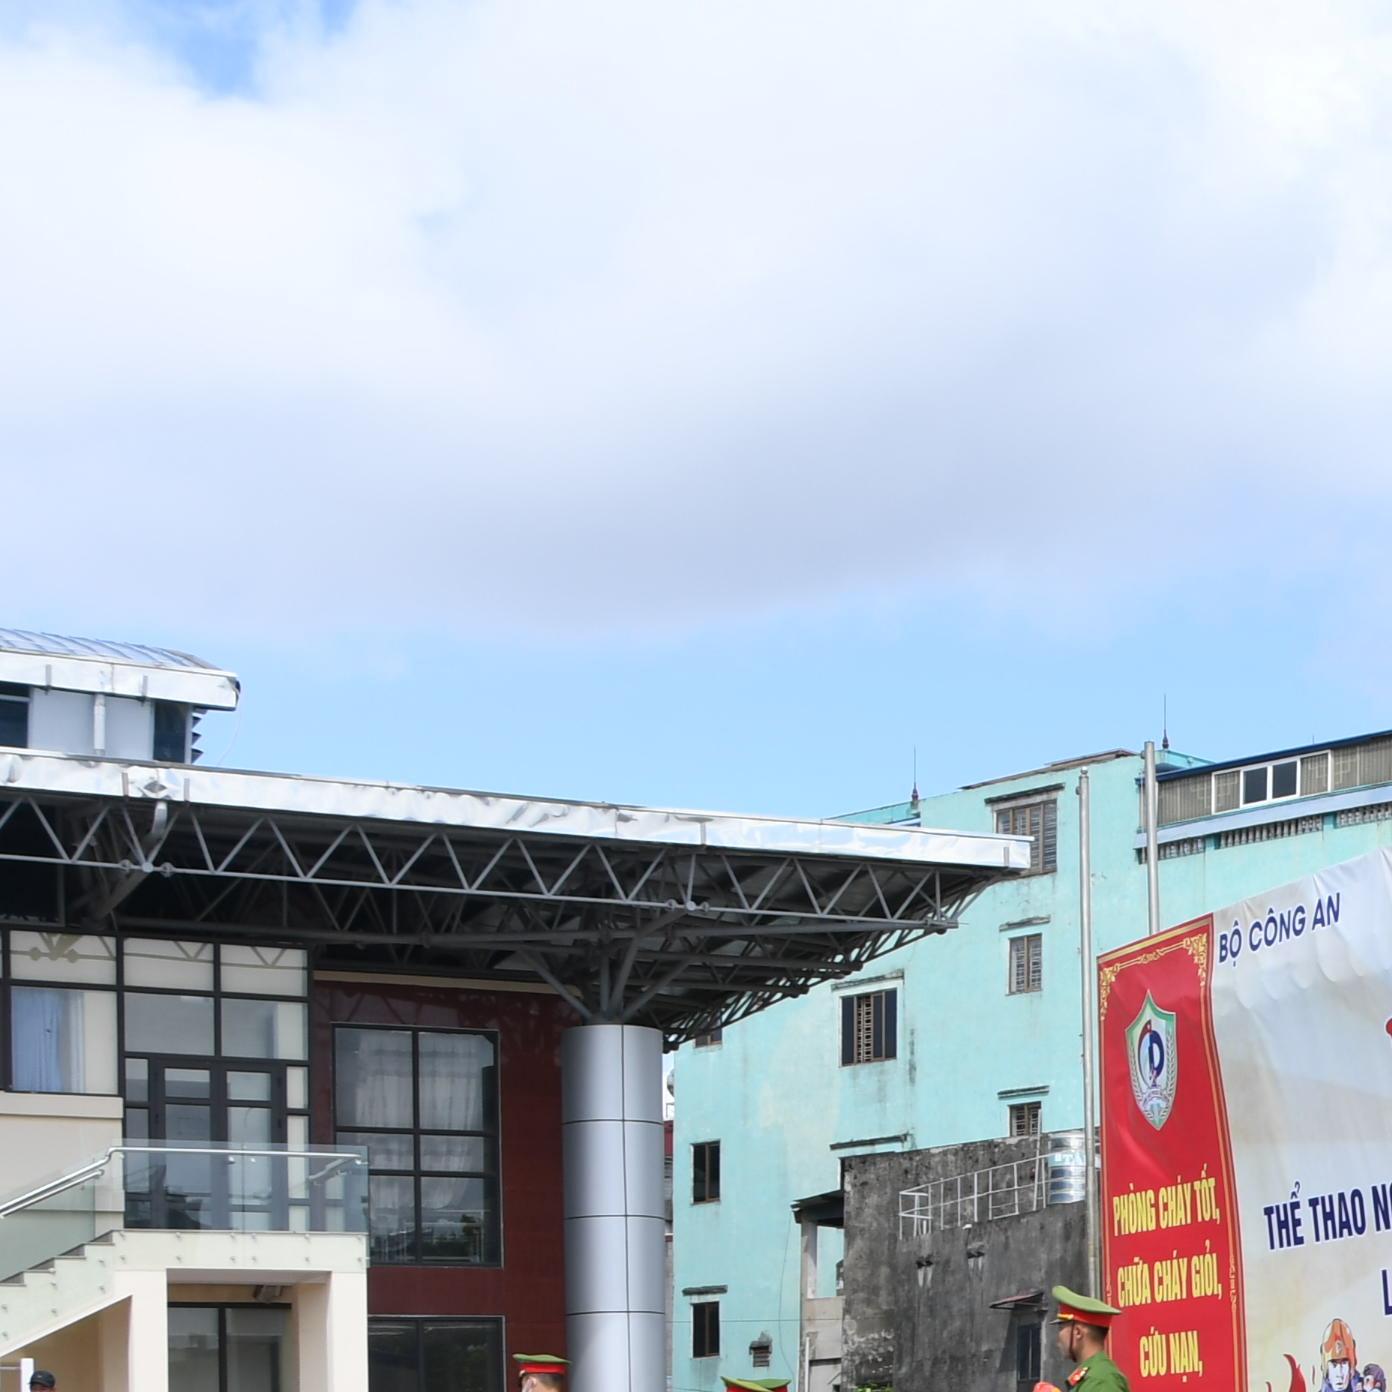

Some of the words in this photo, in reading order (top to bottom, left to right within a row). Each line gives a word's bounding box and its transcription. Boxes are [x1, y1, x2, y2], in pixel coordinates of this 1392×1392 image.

[1219, 920, 1242, 967] BỘ
[1249, 907, 1306, 952] CÔNG
[1312, 892, 1340, 931] AN
[1113, 1183, 1156, 1237] PHÒNG
[1159, 1175, 1192, 1229] CHÁY
[1194, 1163, 1221, 1225] TỐT,
[1264, 1181, 1304, 1250] THỂ
[1308, 1189, 1366, 1242] THAO
[1118, 1256, 1152, 1308] CHỮA
[1154, 1250, 1188, 1303] CHÁY
[1191, 1239, 1222, 1300] GIỎI,
[1140, 1326, 1167, 1377] CỨU
[1169, 1330, 1203, 1383] NẠN,
